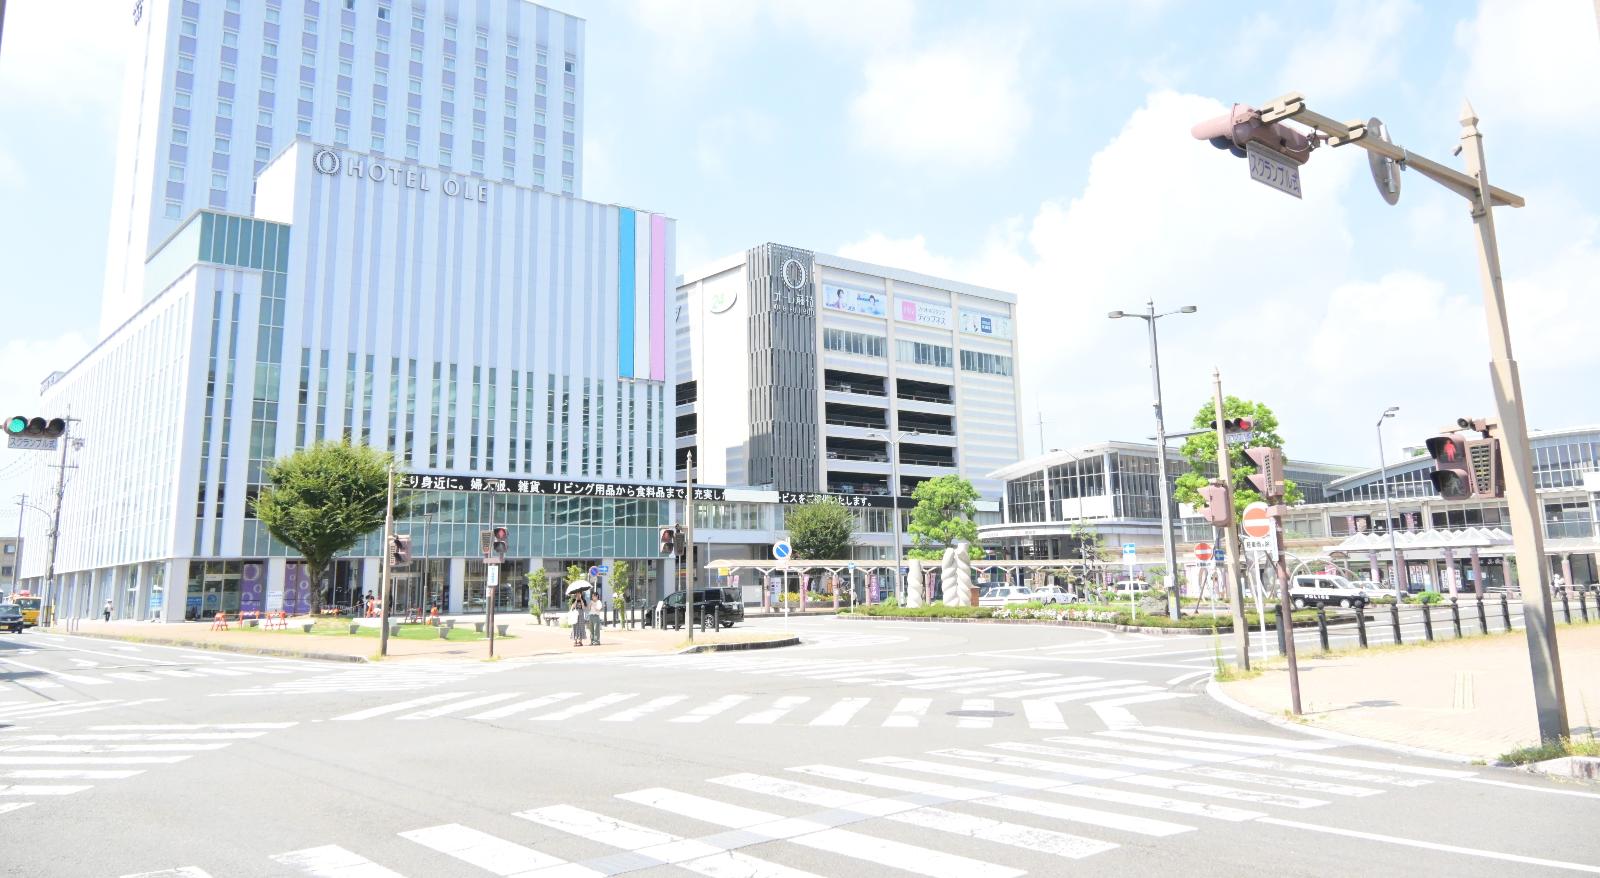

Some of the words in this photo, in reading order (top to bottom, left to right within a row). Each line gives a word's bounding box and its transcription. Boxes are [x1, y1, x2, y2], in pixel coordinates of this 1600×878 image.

[347, 157, 430, 191] HOTEL
[443, 177, 488, 202] OLE
[1251, 154, 1298, 191] スクランブル式
[10, 437, 56, 449] スクランブル式
